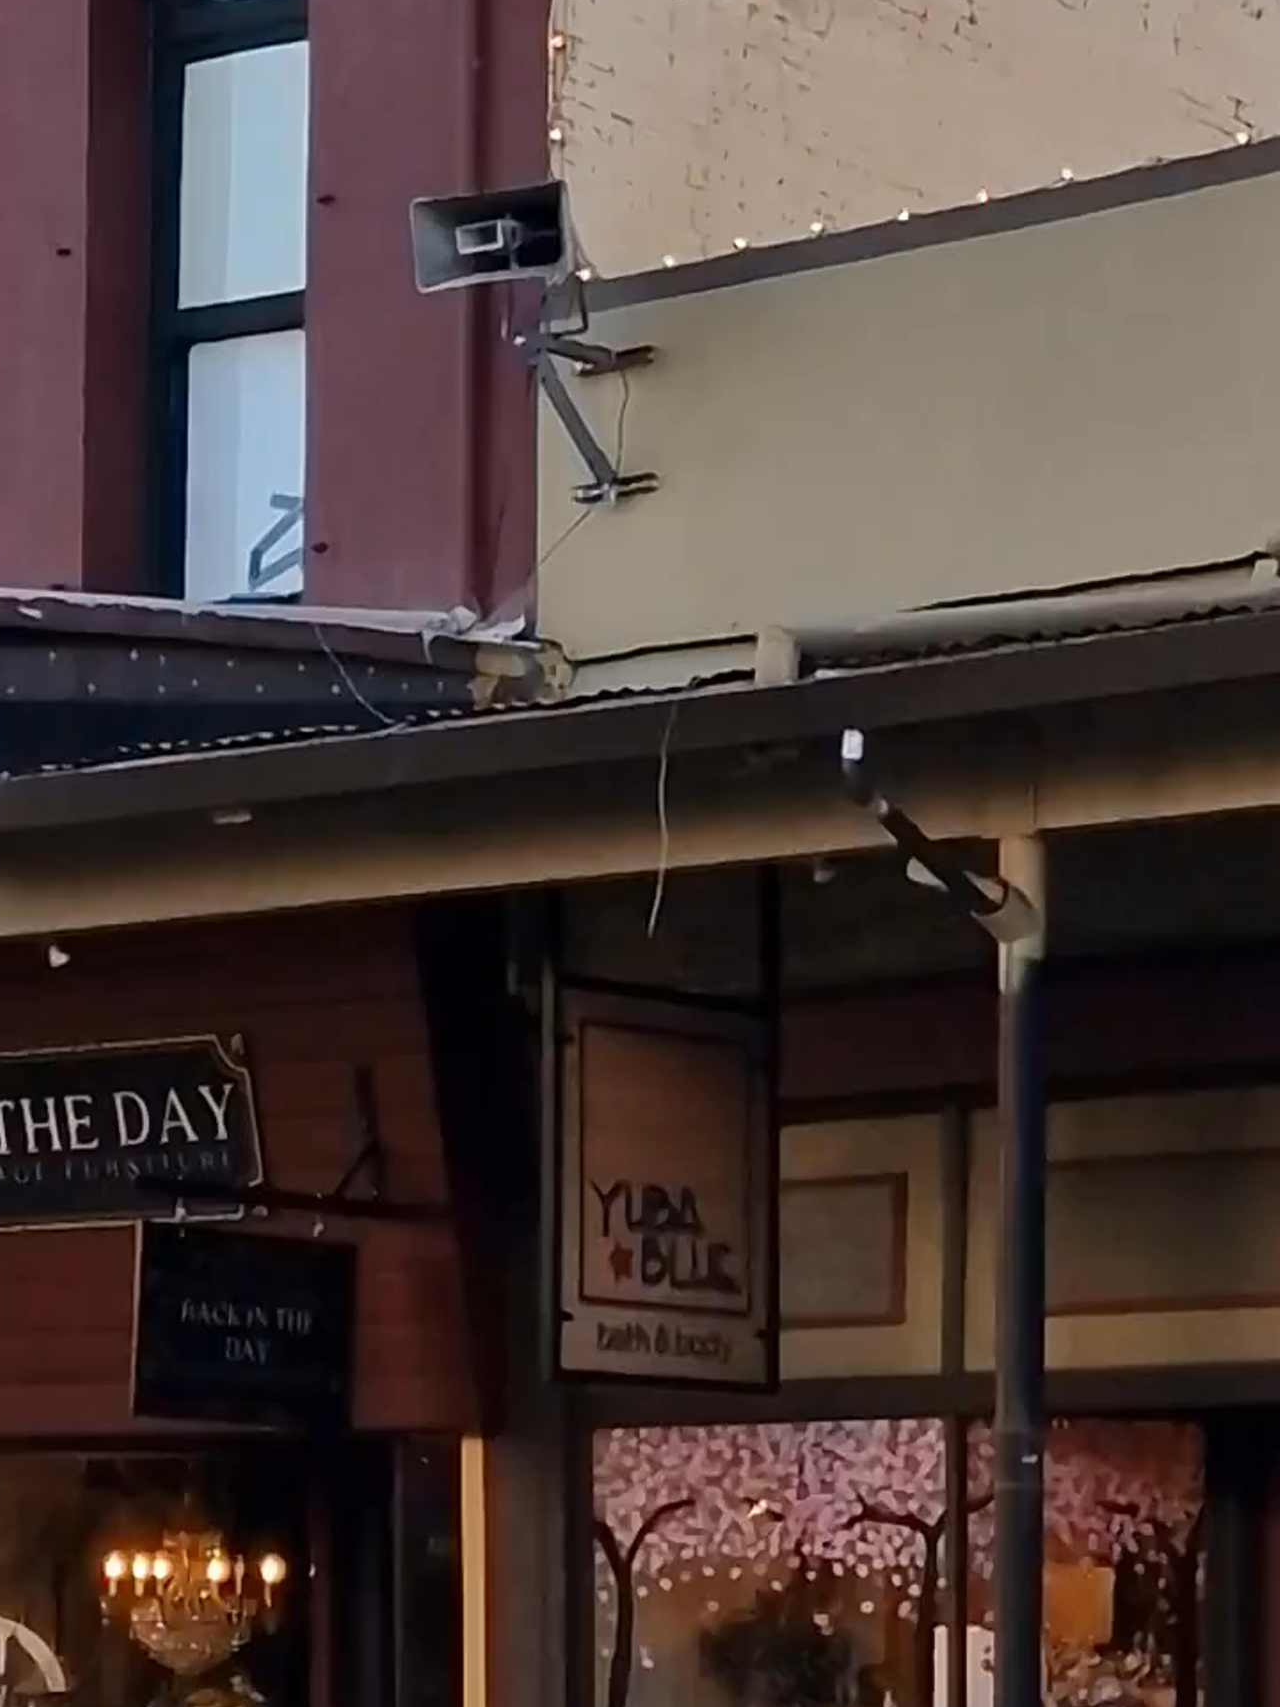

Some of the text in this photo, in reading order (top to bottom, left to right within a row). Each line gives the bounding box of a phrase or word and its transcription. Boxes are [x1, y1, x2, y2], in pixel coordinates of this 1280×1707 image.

[114, 1083, 234, 1147] DAY
[180, 1297, 240, 1327] BACK
[225, 1336, 270, 1365] DAY
